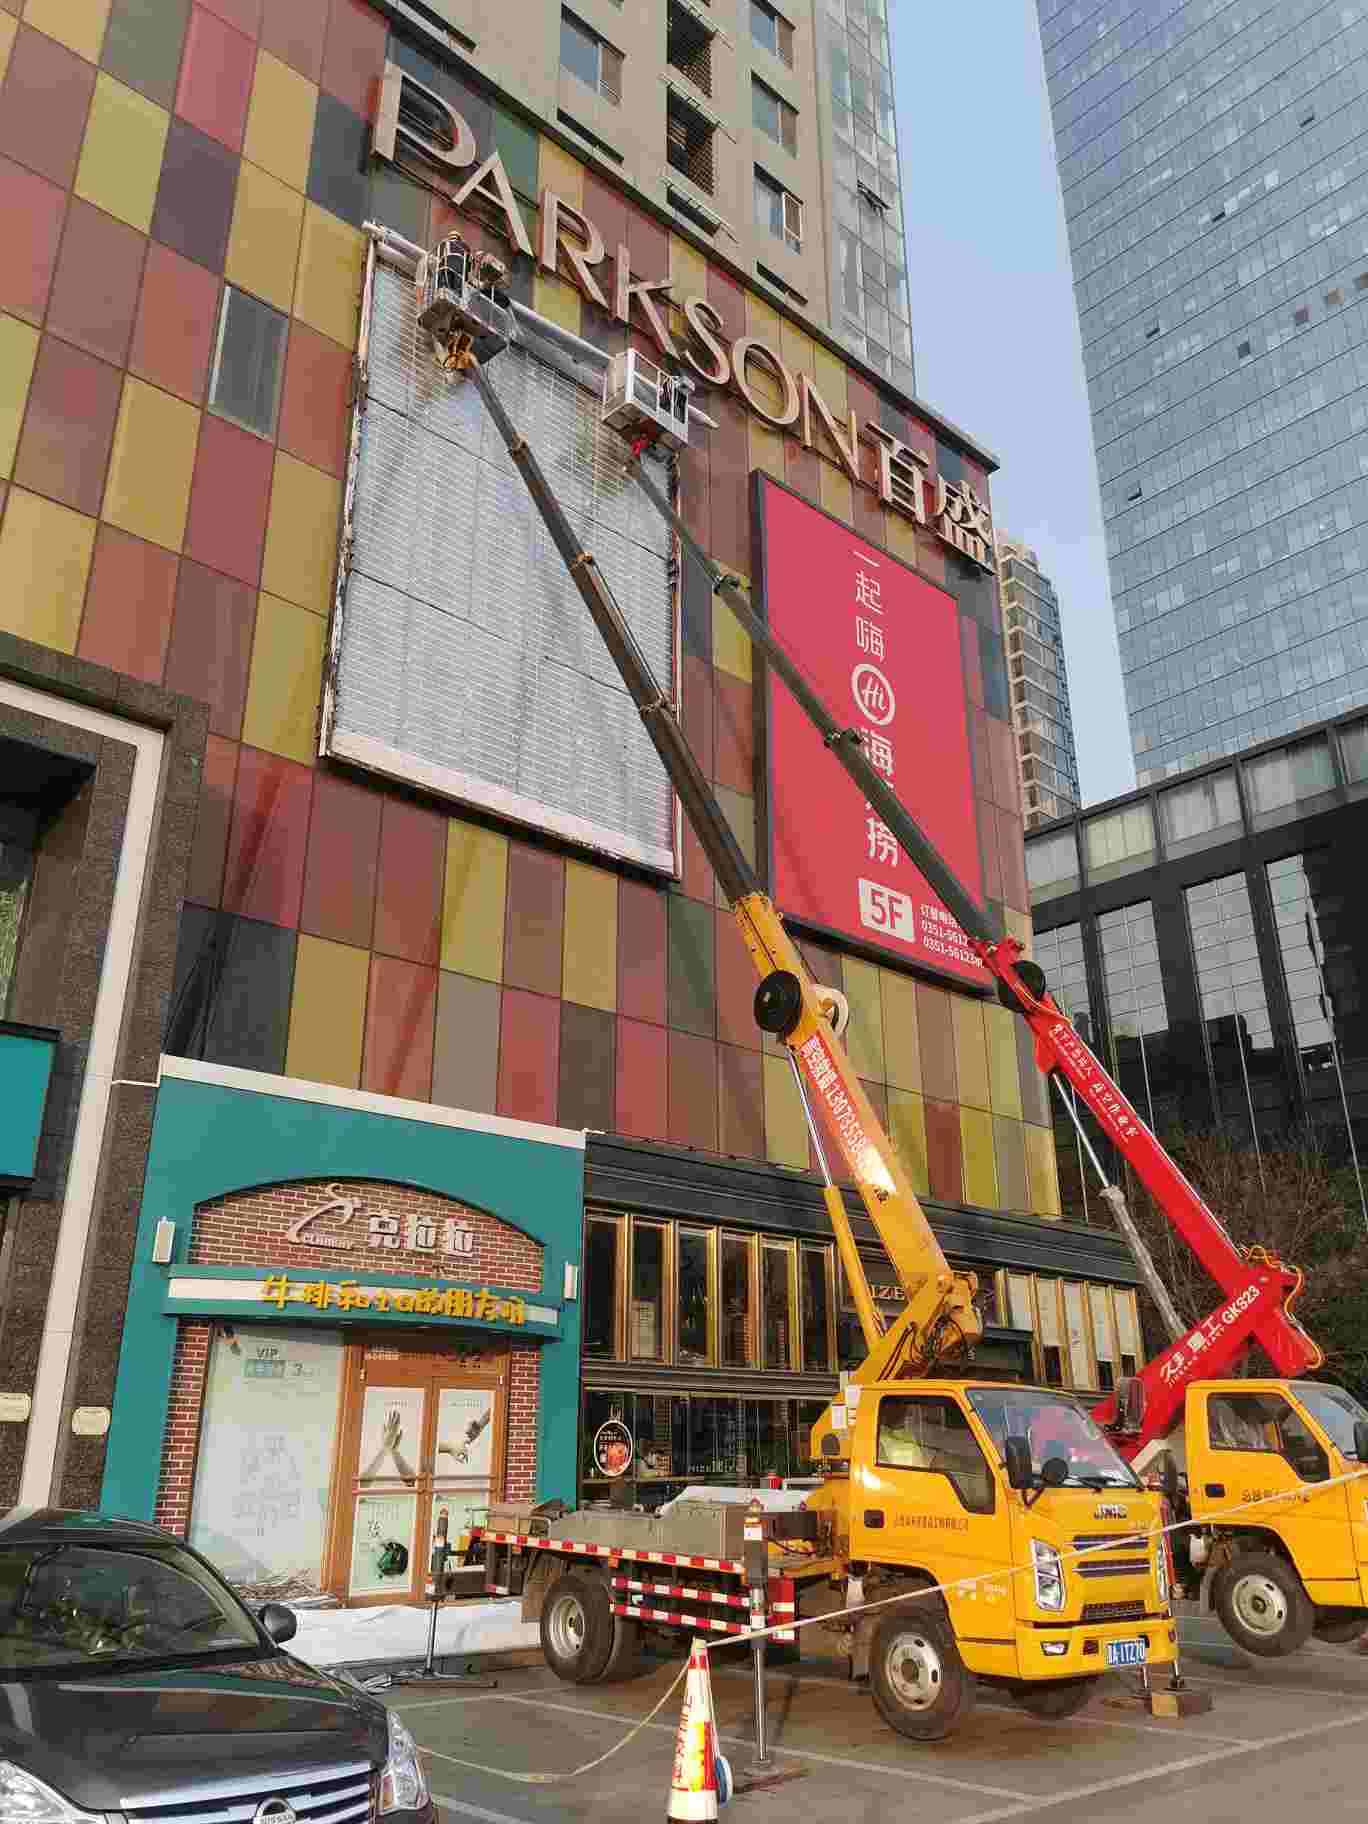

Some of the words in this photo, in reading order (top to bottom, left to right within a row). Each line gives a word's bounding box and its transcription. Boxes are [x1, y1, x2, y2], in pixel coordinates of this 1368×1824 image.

[371, 61, 862, 482] PARKSON
[866, 422, 992, 566] 百盛
[852, 549, 885, 661] 一起嗨
[860, 728, 899, 867] 海捞
[869, 887, 903, 930] 5F
[1221, 1285, 1260, 1325] GKS23
